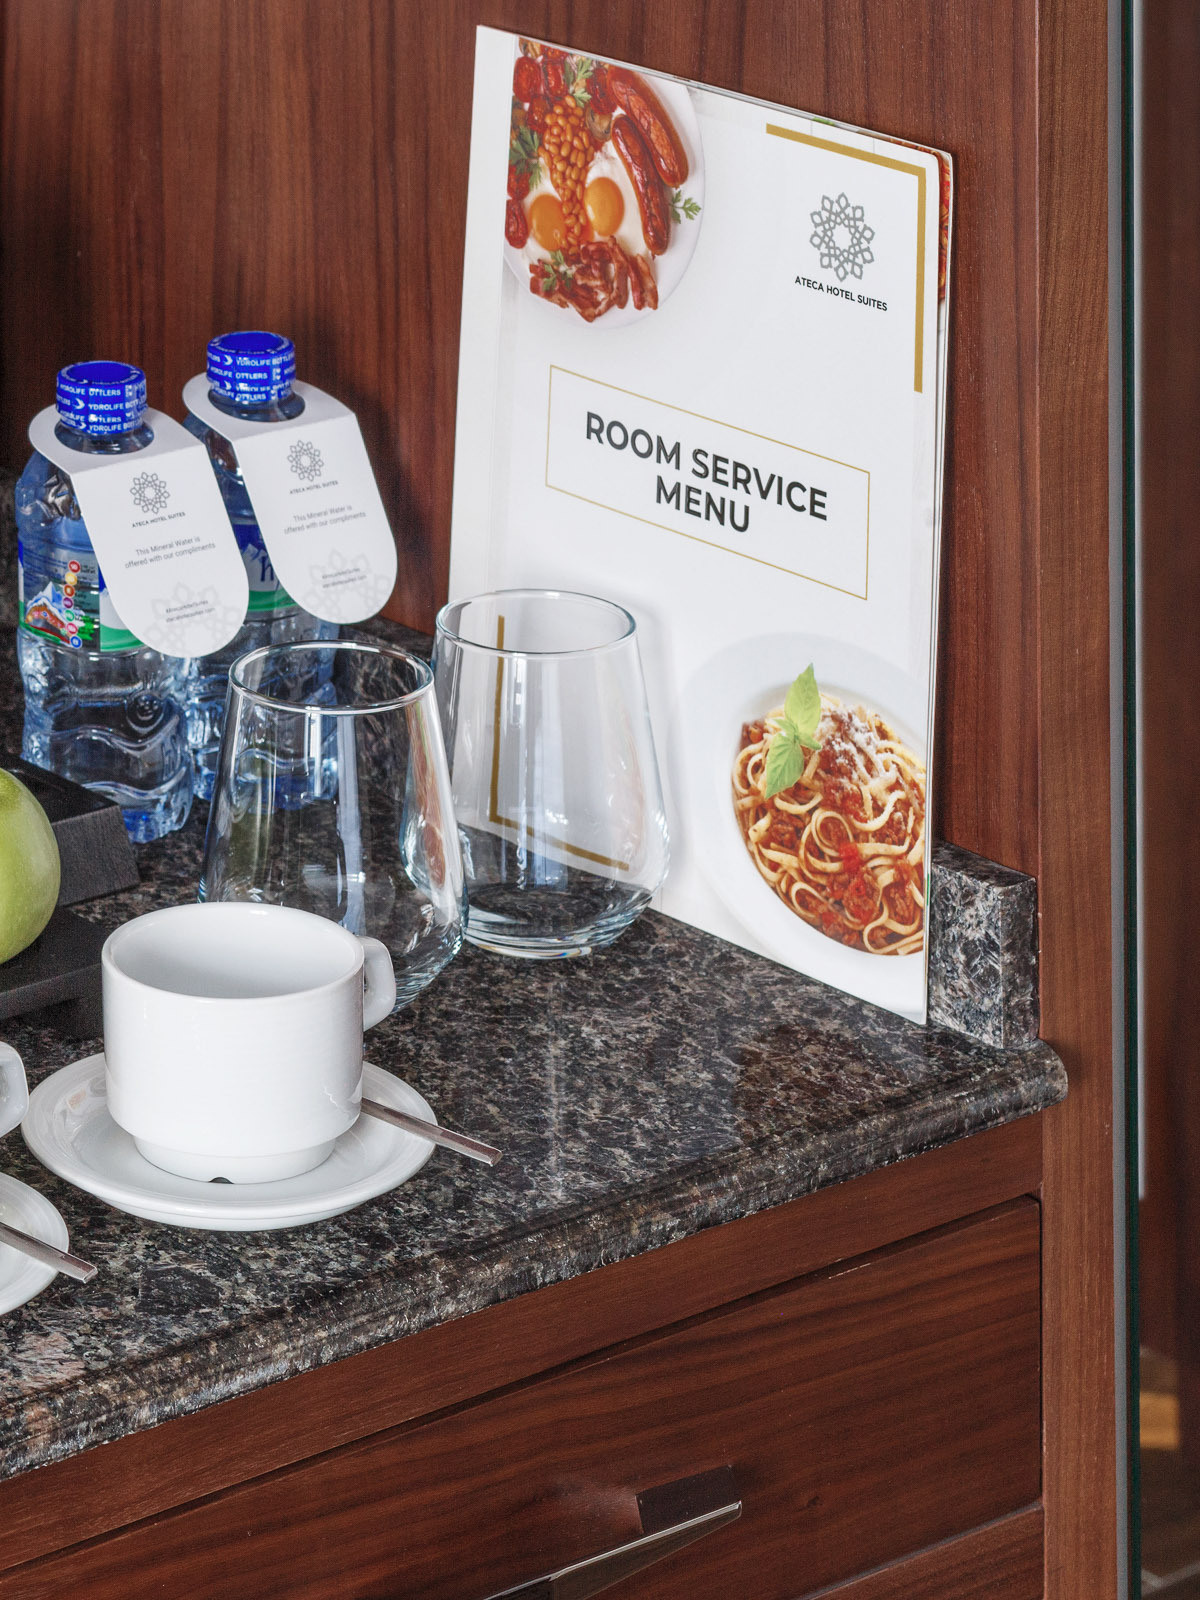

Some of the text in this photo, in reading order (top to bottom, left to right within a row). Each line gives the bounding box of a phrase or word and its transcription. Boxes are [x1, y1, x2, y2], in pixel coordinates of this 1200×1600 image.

[795, 276, 888, 312] ATECA HOTEL SUITES
[586, 411, 828, 521] ROOM SERVICE
[293, 515, 306, 523] This
[306, 510, 328, 520] Mineral
[329, 506, 346, 515] Water
[656, 475, 750, 533] MENU
[132, 511, 186, 528] ATECA HOTEL SUITES
[306, 521, 318, 530] with
[124, 542, 216, 569] offered with our compliments
[150, 542, 174, 553] Mineral
[174, 537, 194, 547] Water
